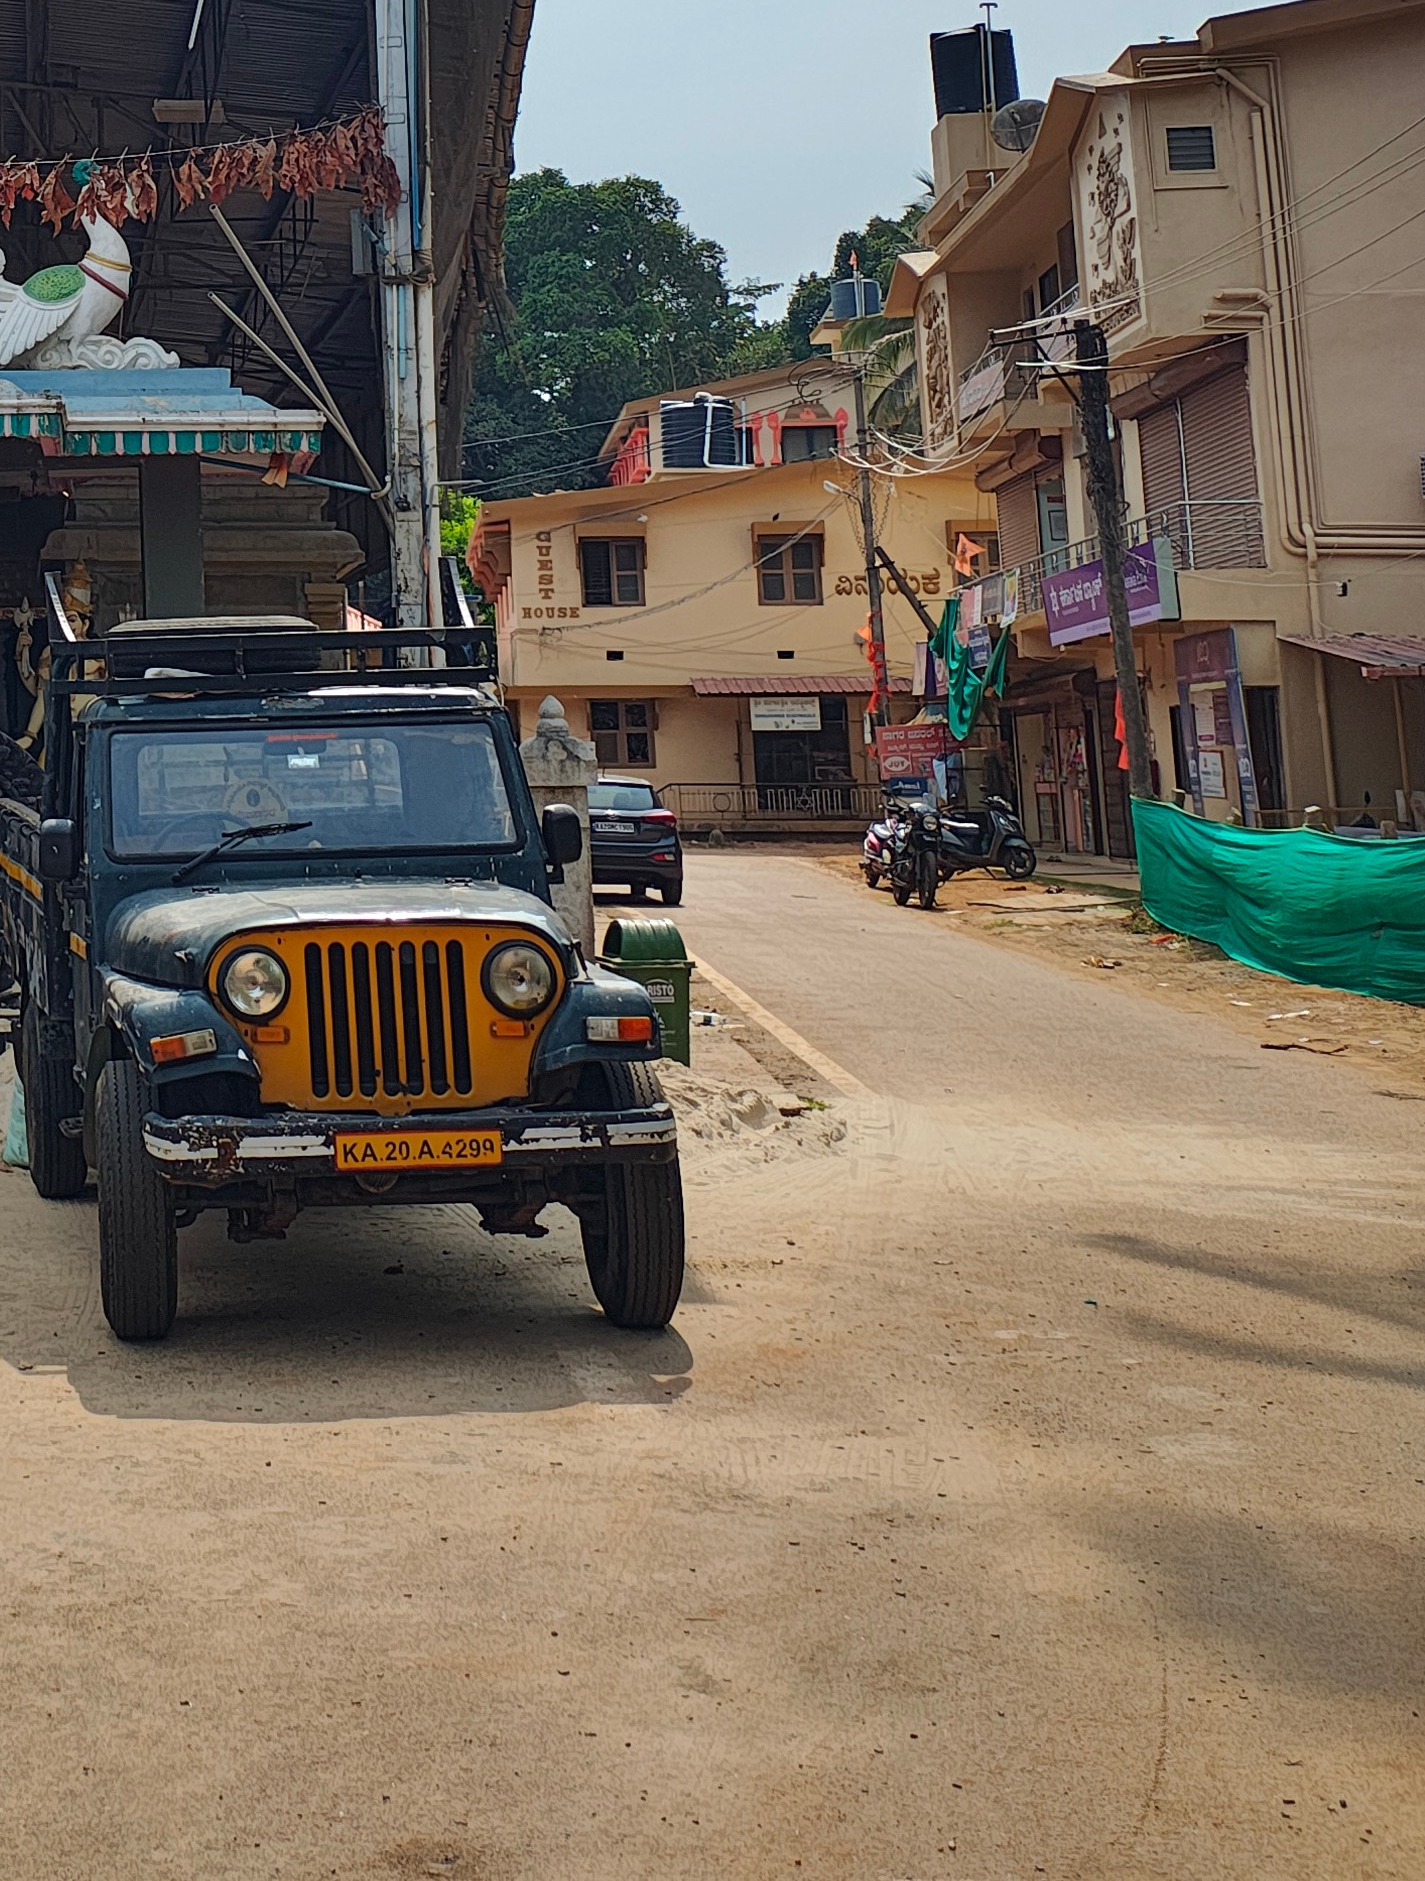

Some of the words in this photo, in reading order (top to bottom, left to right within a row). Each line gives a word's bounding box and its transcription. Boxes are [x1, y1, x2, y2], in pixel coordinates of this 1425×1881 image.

[536, 531, 555, 600] GUEST
[521, 607, 580, 619] HOUSE
[887, 760, 906, 768] JOY
[647, 984, 675, 996] RISTO
